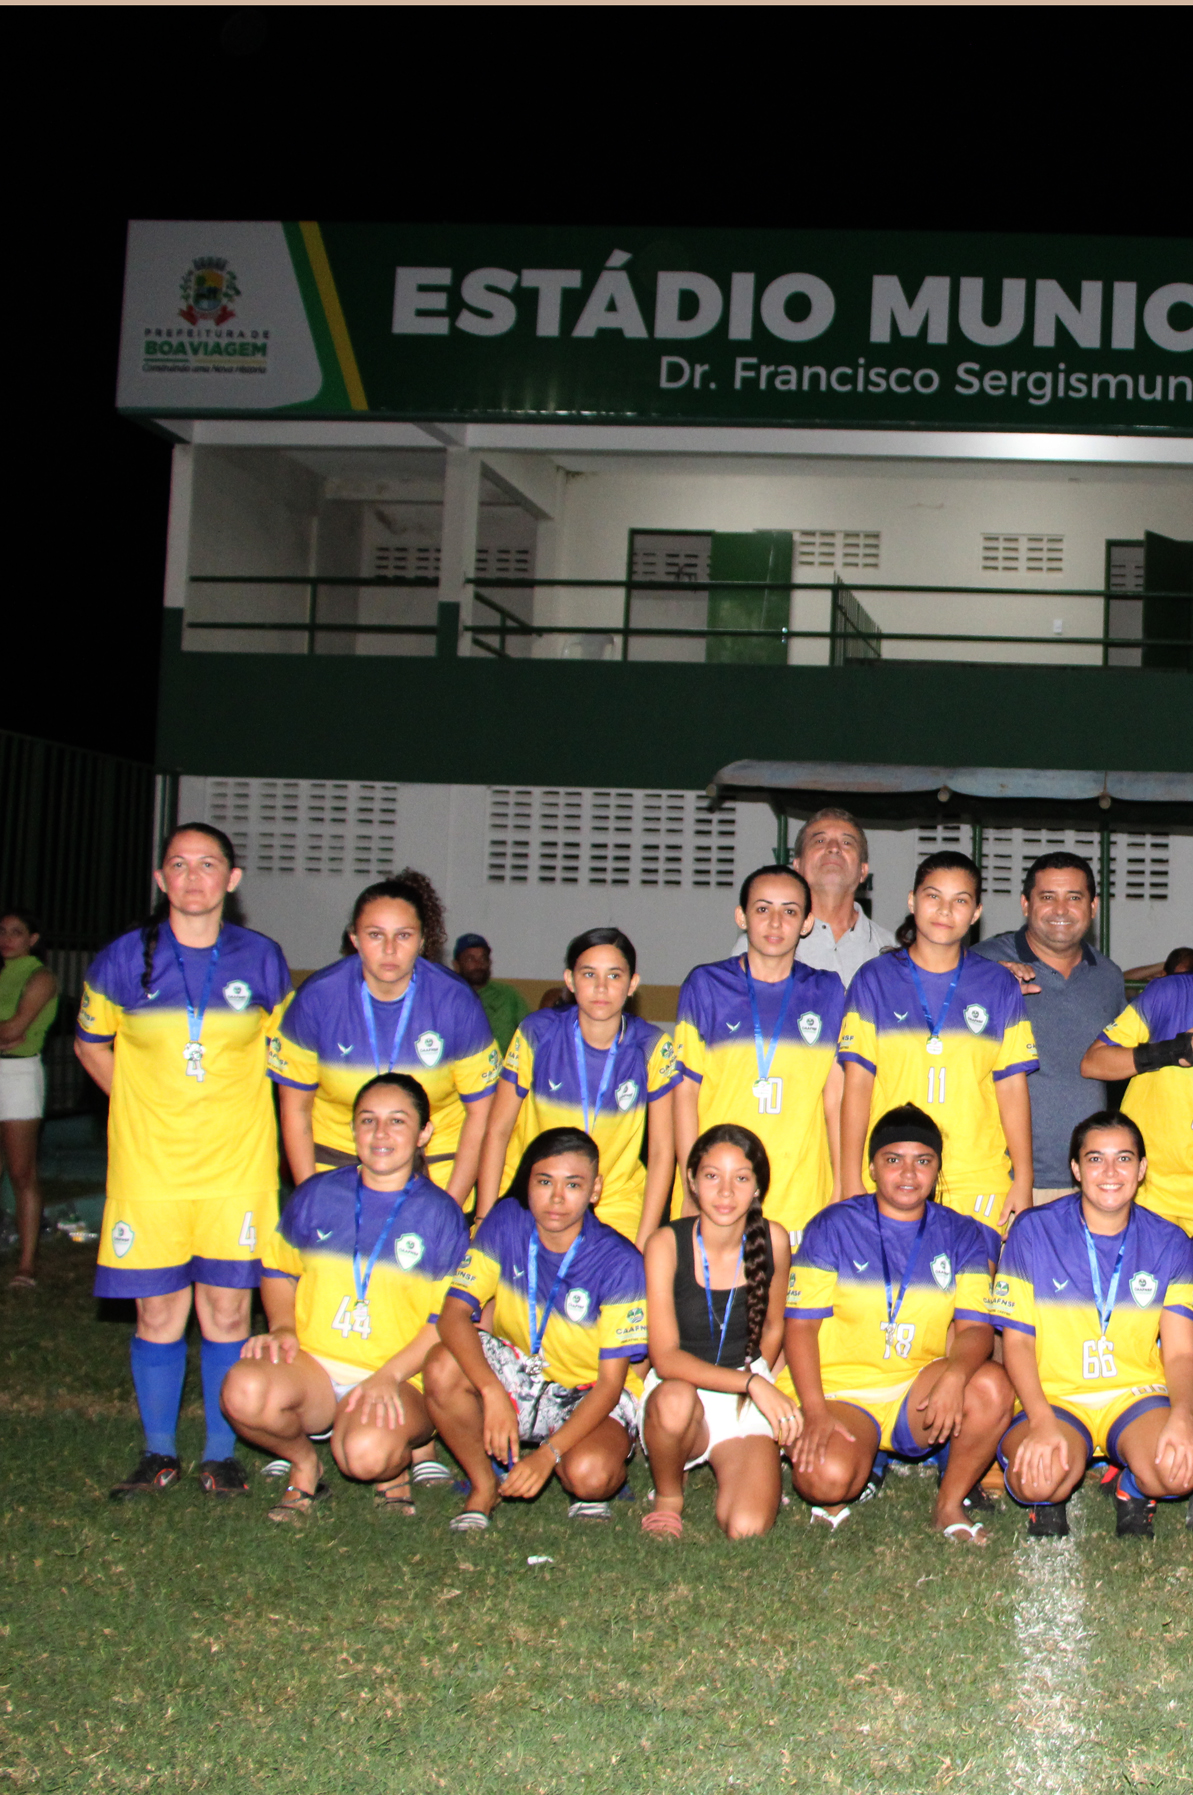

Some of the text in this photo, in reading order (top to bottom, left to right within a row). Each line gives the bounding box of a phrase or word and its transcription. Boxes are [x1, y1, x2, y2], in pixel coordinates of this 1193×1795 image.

[391, 248, 836, 343] ESTÁDIO
[144, 328, 270, 339] PREFEITURA DE
[659, 355, 716, 390] Dr.
[734, 356, 940, 394] Francisco
[186, 1060, 206, 1082] 4
[926, 1066, 947, 1104] 11
[758, 1076, 784, 1115] 10
[974, 1193, 996, 1218] 11
[238, 1211, 257, 1252] 4
[331, 1295, 371, 1340] 44
[615, 1324, 648, 1336] CAAFN
[1082, 1339, 1118, 1379] 66
